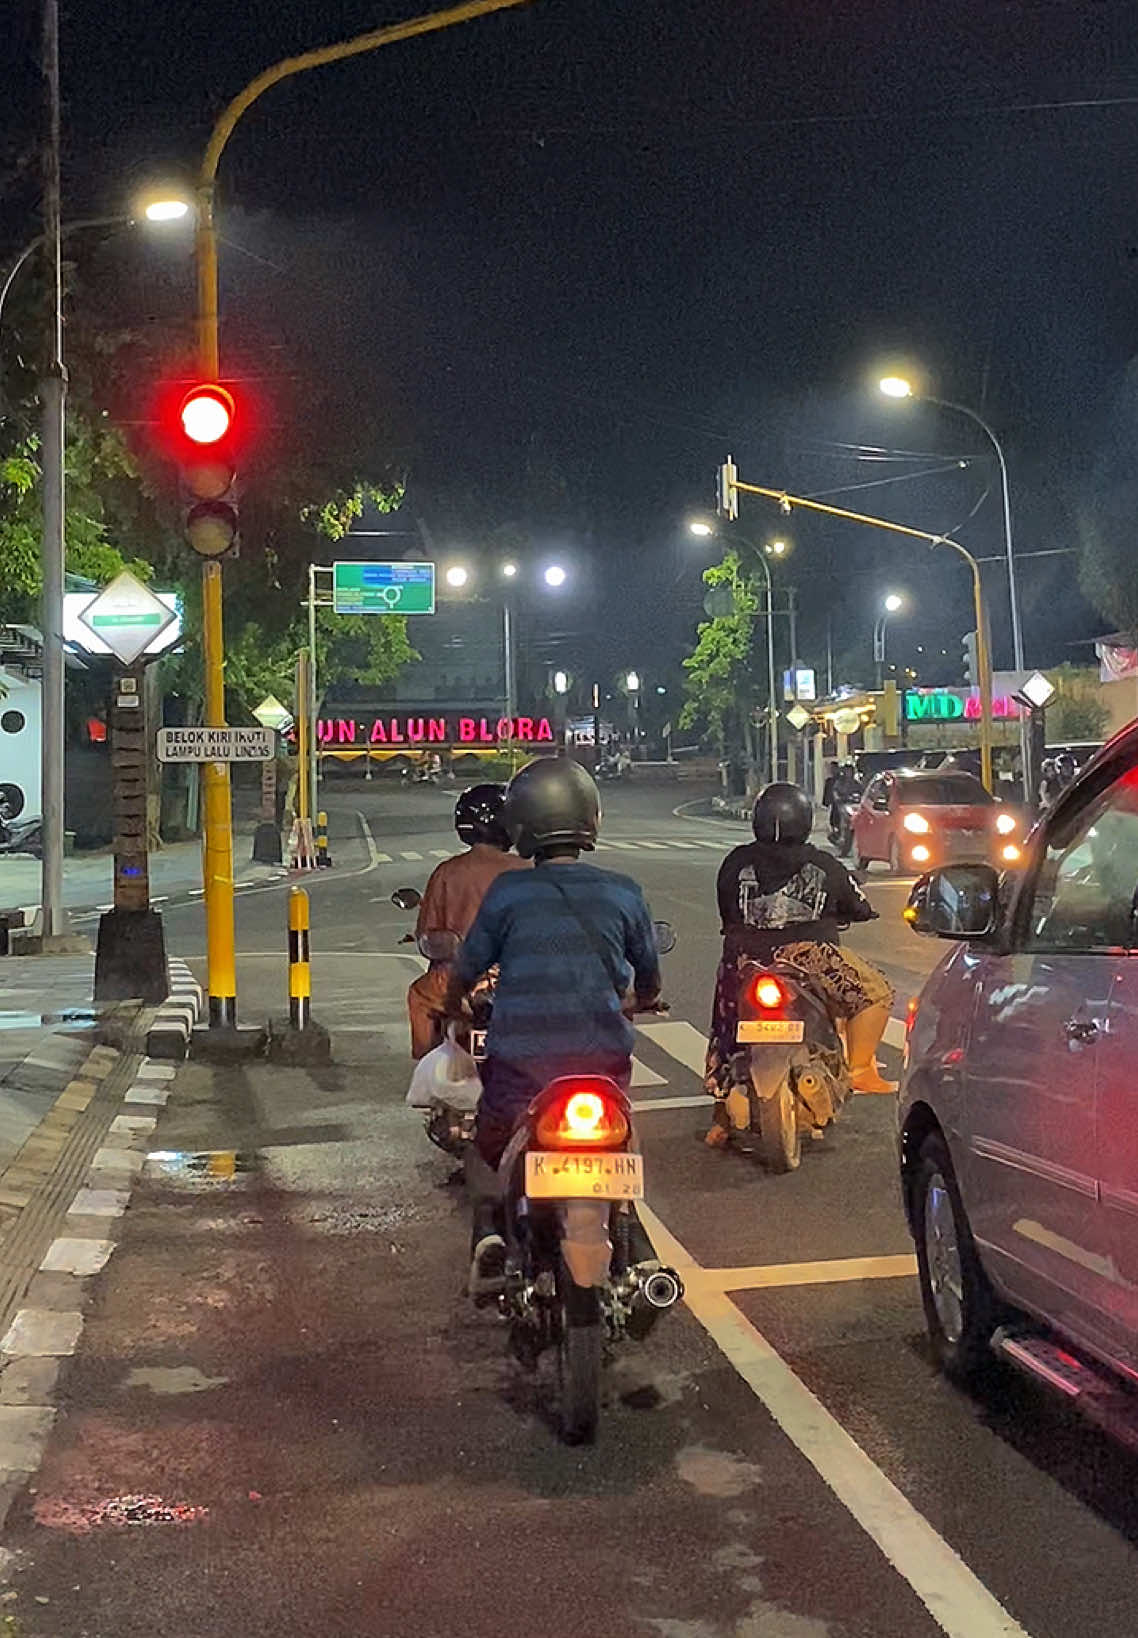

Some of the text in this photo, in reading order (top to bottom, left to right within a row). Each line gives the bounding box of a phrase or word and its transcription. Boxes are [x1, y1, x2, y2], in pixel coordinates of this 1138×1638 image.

[905, 695, 963, 719] MD
[166, 731, 204, 743] BELOK
[208, 731, 231, 743] KIRI
[371, 718, 445, 742] ALUN
[460, 717, 553, 741] BLORA
[166, 745, 201, 757] LAMPU
[204, 745, 231, 757] LALU
[534, 1155, 545, 1176] K
[615, 1157, 637, 1175] HN
